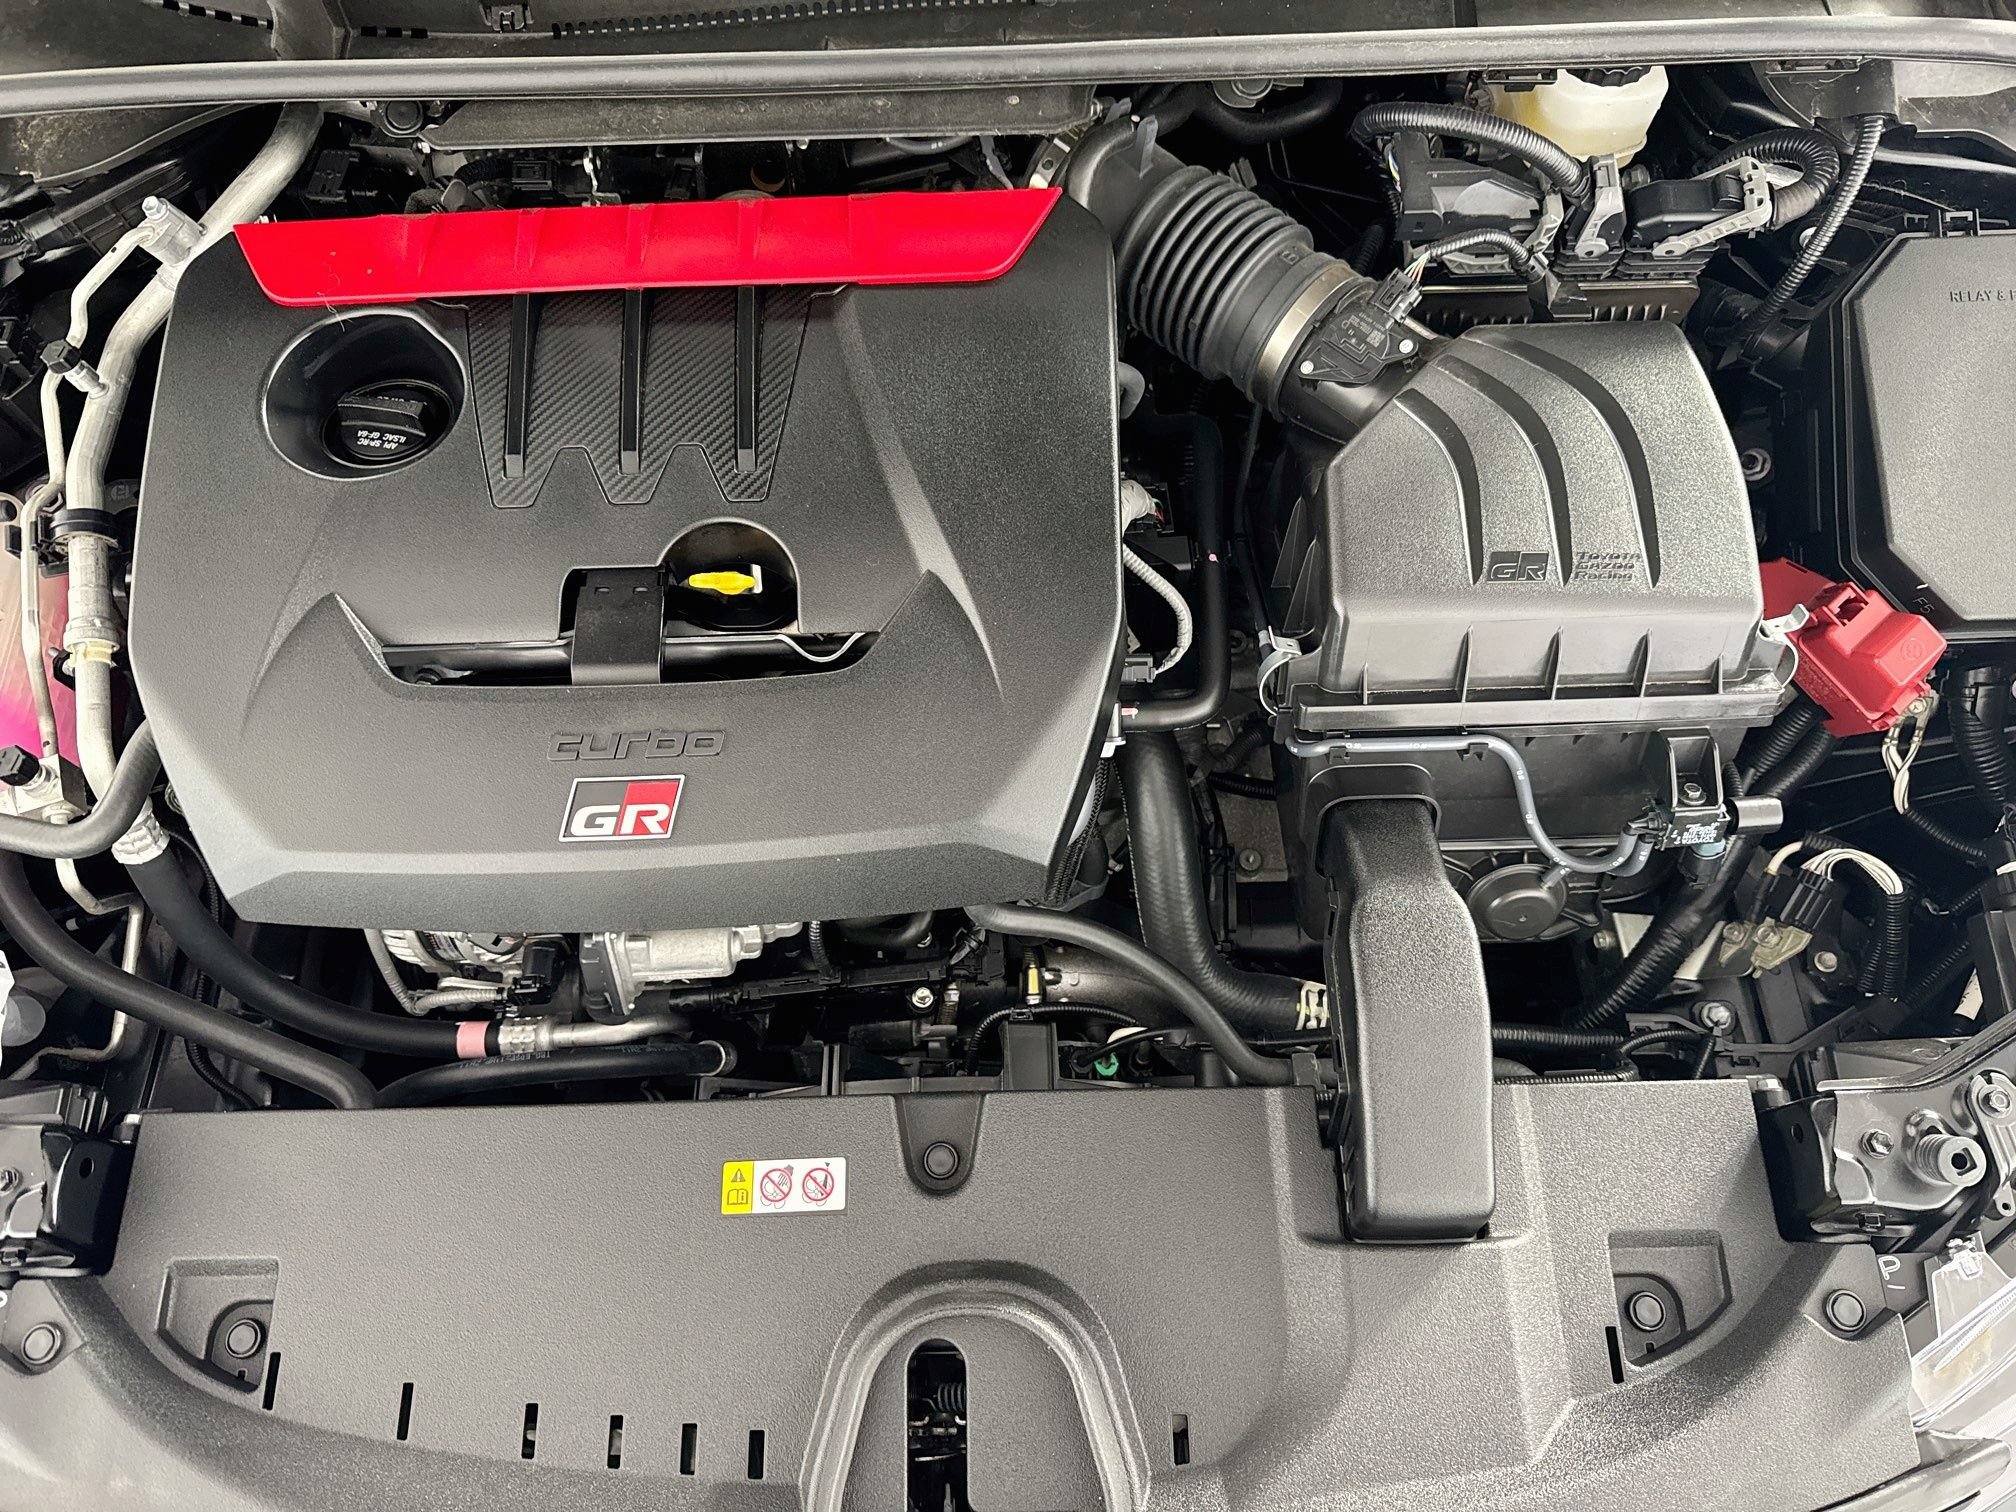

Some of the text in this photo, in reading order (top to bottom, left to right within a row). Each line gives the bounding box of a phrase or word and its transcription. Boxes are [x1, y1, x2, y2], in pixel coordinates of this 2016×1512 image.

[1949, 290, 1992, 302] RELAY
[1996, 289, 2006, 301] &
[357, 430, 407, 443] ILSAC GF-6A
[383, 441, 399, 450] API
[1576, 551, 1641, 560] TOYOTA
[1575, 561, 1635, 570] GAZOO
[1574, 570, 1634, 582] Racing
[547, 729, 726, 761] turbo
[570, 803, 670, 837] GR
